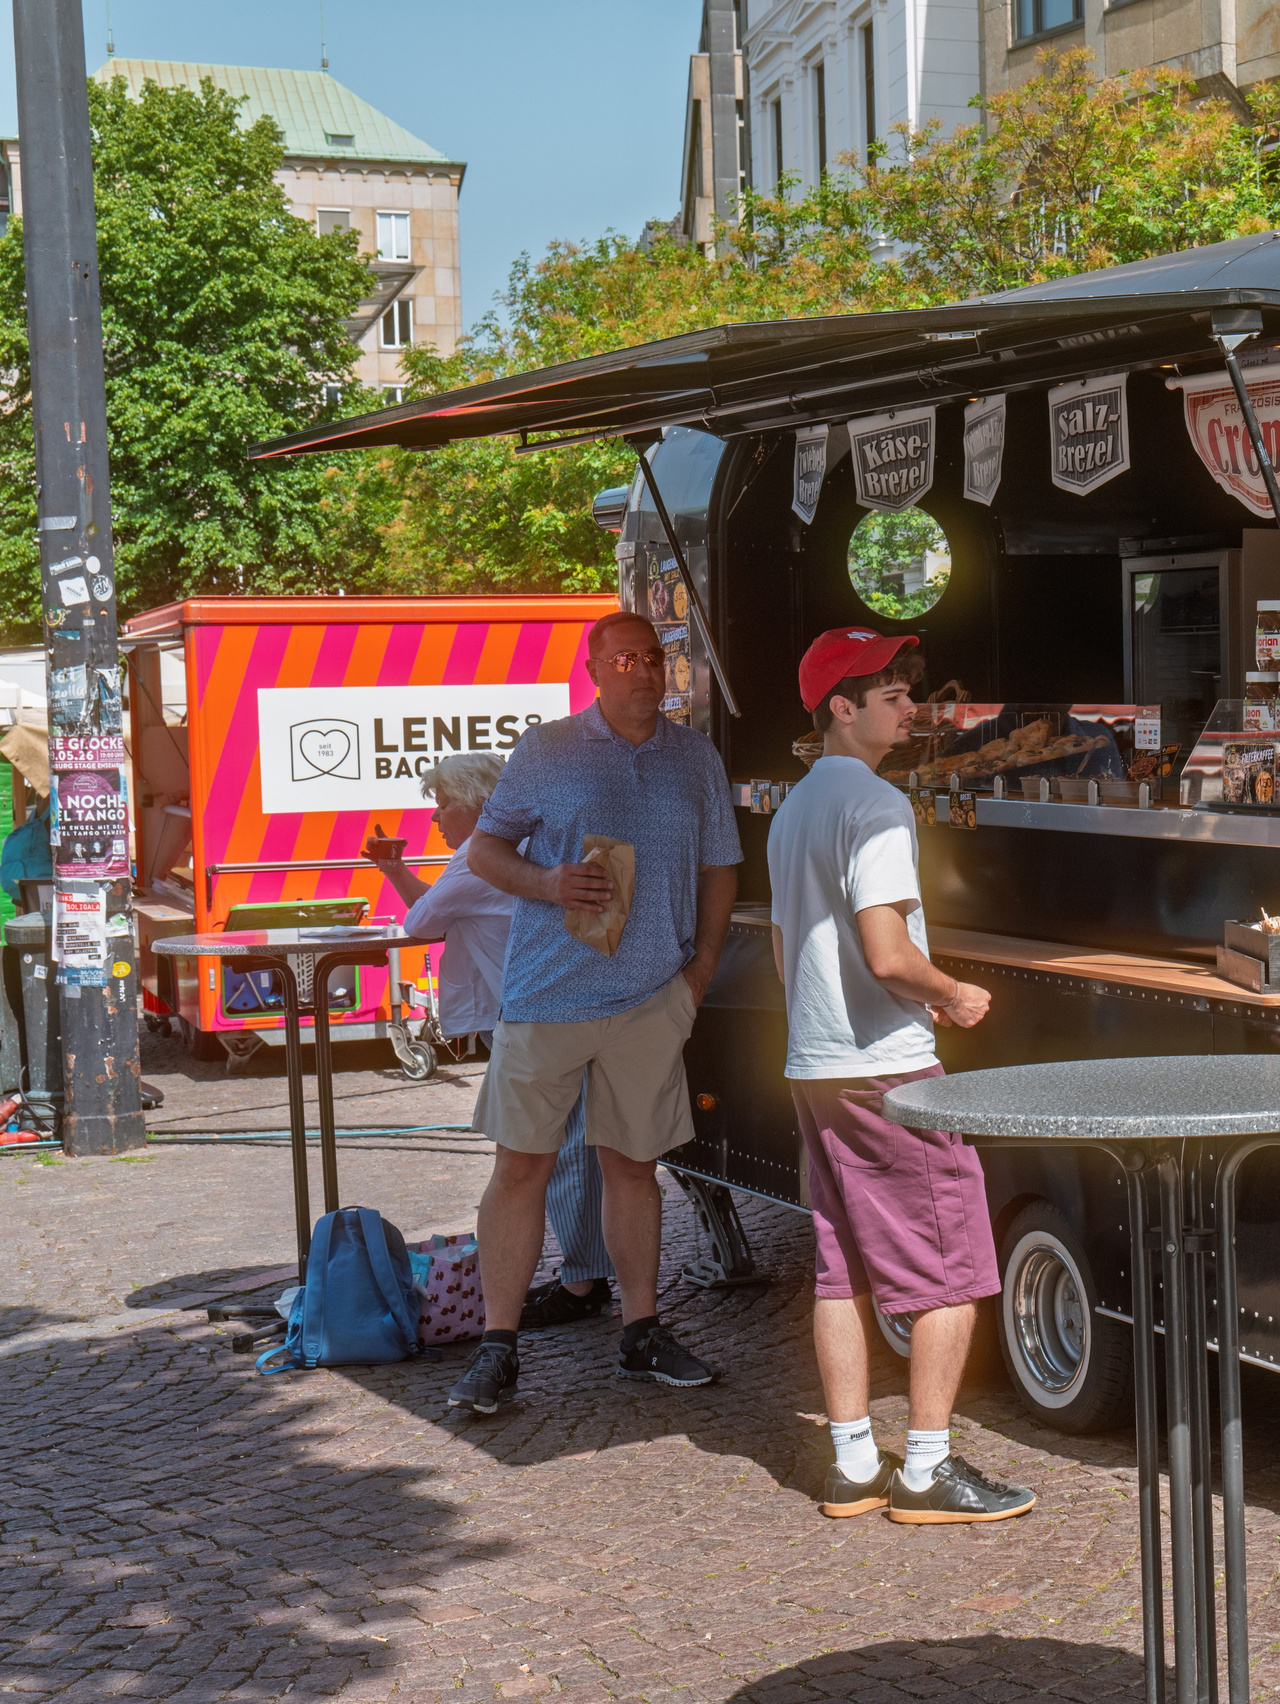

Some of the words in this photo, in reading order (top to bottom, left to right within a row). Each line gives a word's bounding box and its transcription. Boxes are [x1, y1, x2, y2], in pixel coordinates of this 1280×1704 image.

[1058, 402, 1120, 441] Salz-
[862, 434, 930, 470] Käse-
[1058, 435, 1113, 473] Brezel
[865, 460, 926, 497] Brezel
[1245, 707, 1261, 717] leon
[68, 737, 123, 750] GLOCKE
[58, 810, 71, 821] EL
[76, 808, 125, 821] TANGO
[66, 903, 100, 911] SOLIGALA
